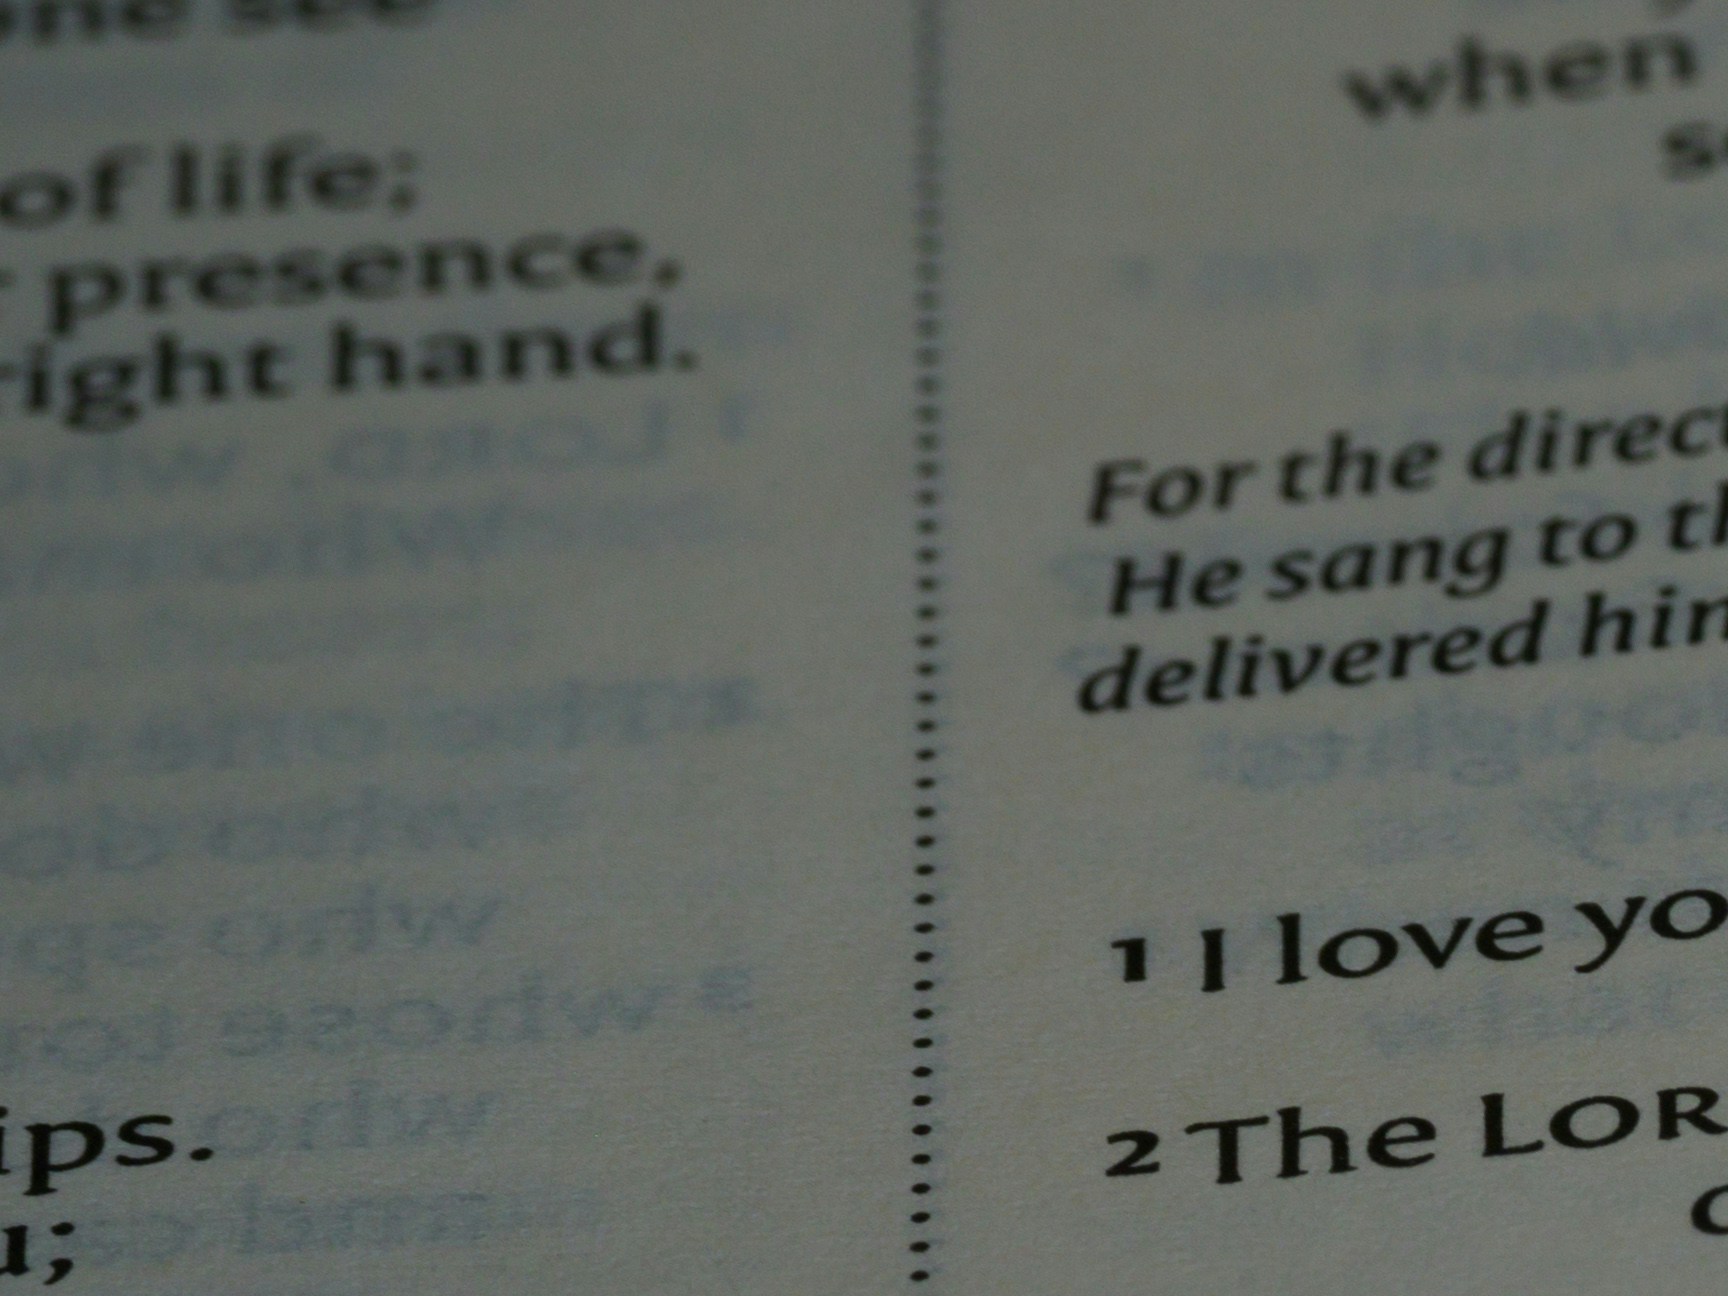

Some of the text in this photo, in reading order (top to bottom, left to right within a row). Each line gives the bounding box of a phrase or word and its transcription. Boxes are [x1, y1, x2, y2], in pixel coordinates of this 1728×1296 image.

[1344, 36, 1698, 122] when
[168, 137, 416, 218] life;
[47, 232, 682, 338] presence,
[328, 302, 694, 392] hand.
[1088, 462, 1255, 526] For
[1278, 429, 1441, 504] the
[1110, 552, 1244, 618] He
[1267, 527, 1512, 601] sang
[1538, 512, 1639, 570] to
[1075, 600, 1551, 716] delivered
[1112, 936, 1148, 984] 1
[1200, 927, 1226, 994] I
[1275, 910, 1546, 987] love
[1104, 1130, 1162, 1178] 2
[1184, 1106, 1438, 1186] The
